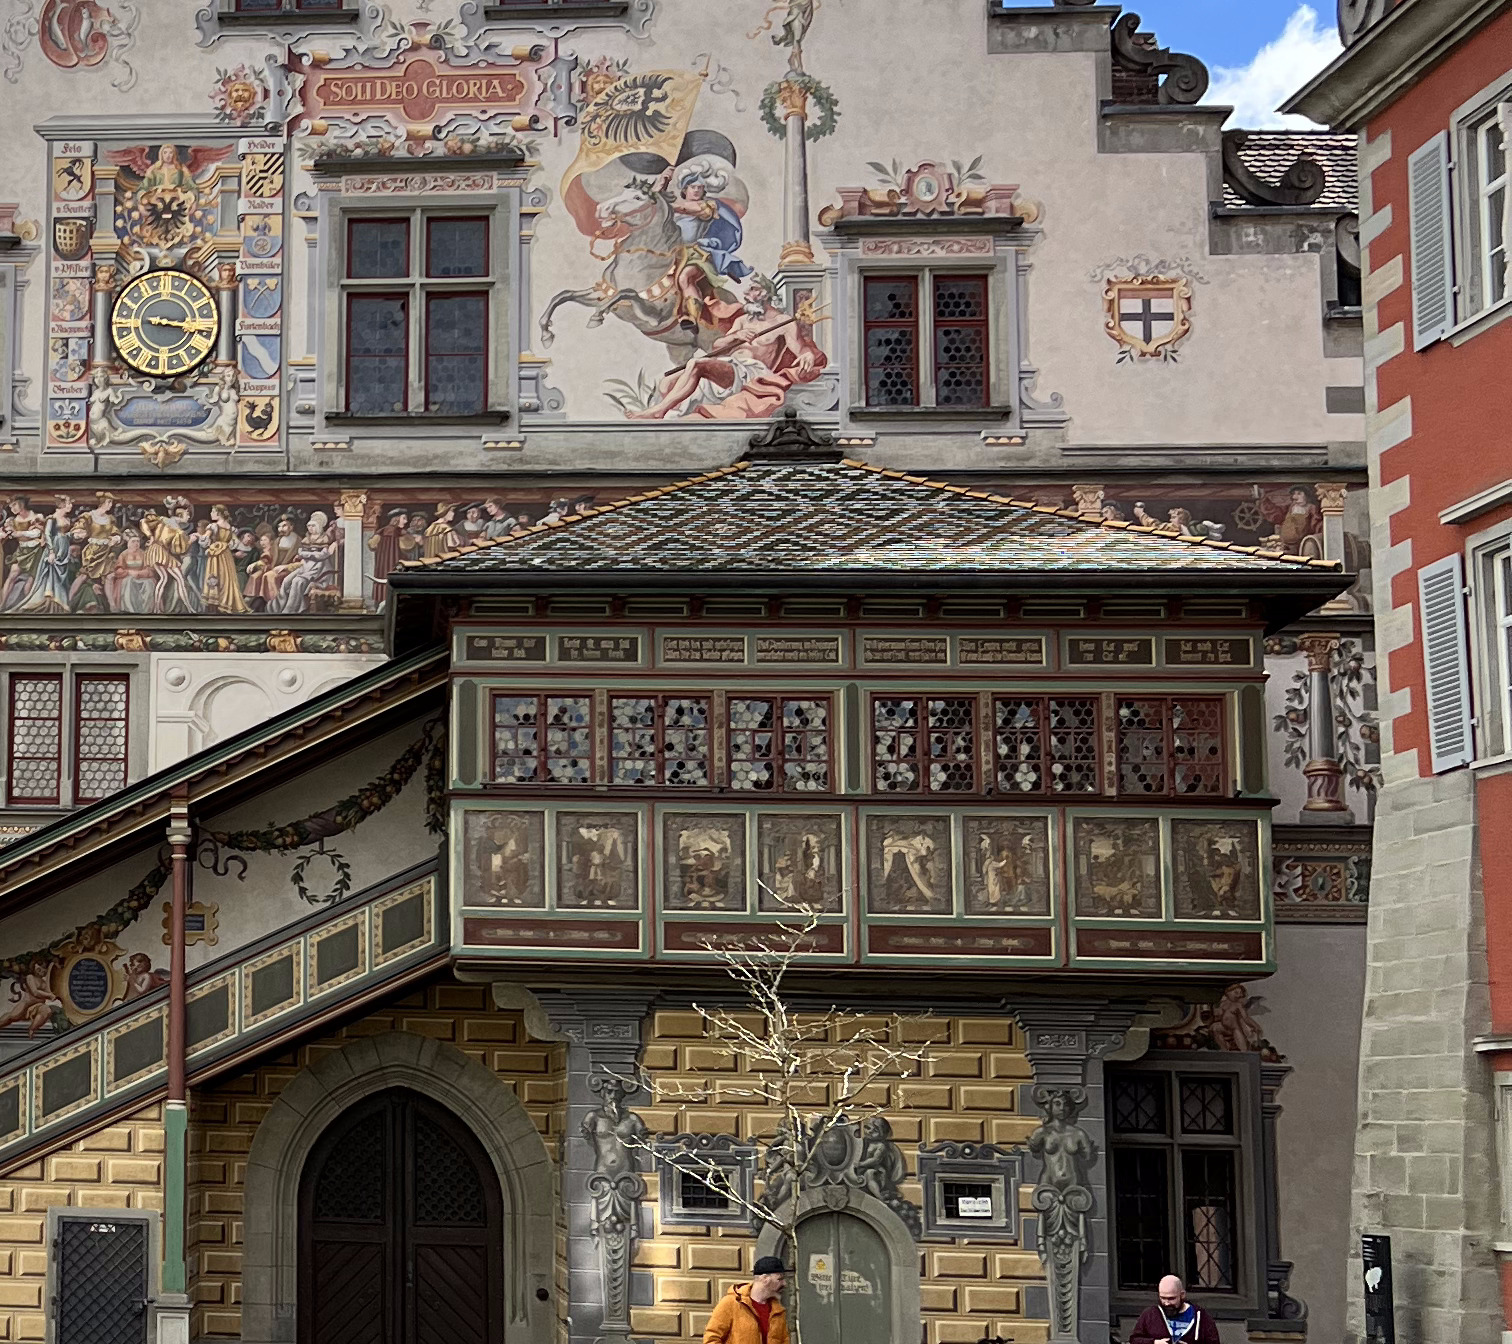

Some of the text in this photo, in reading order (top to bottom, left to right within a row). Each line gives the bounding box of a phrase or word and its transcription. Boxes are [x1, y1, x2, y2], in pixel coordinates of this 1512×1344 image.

[330, 78, 507, 101] SOLI DEO GLORIA
